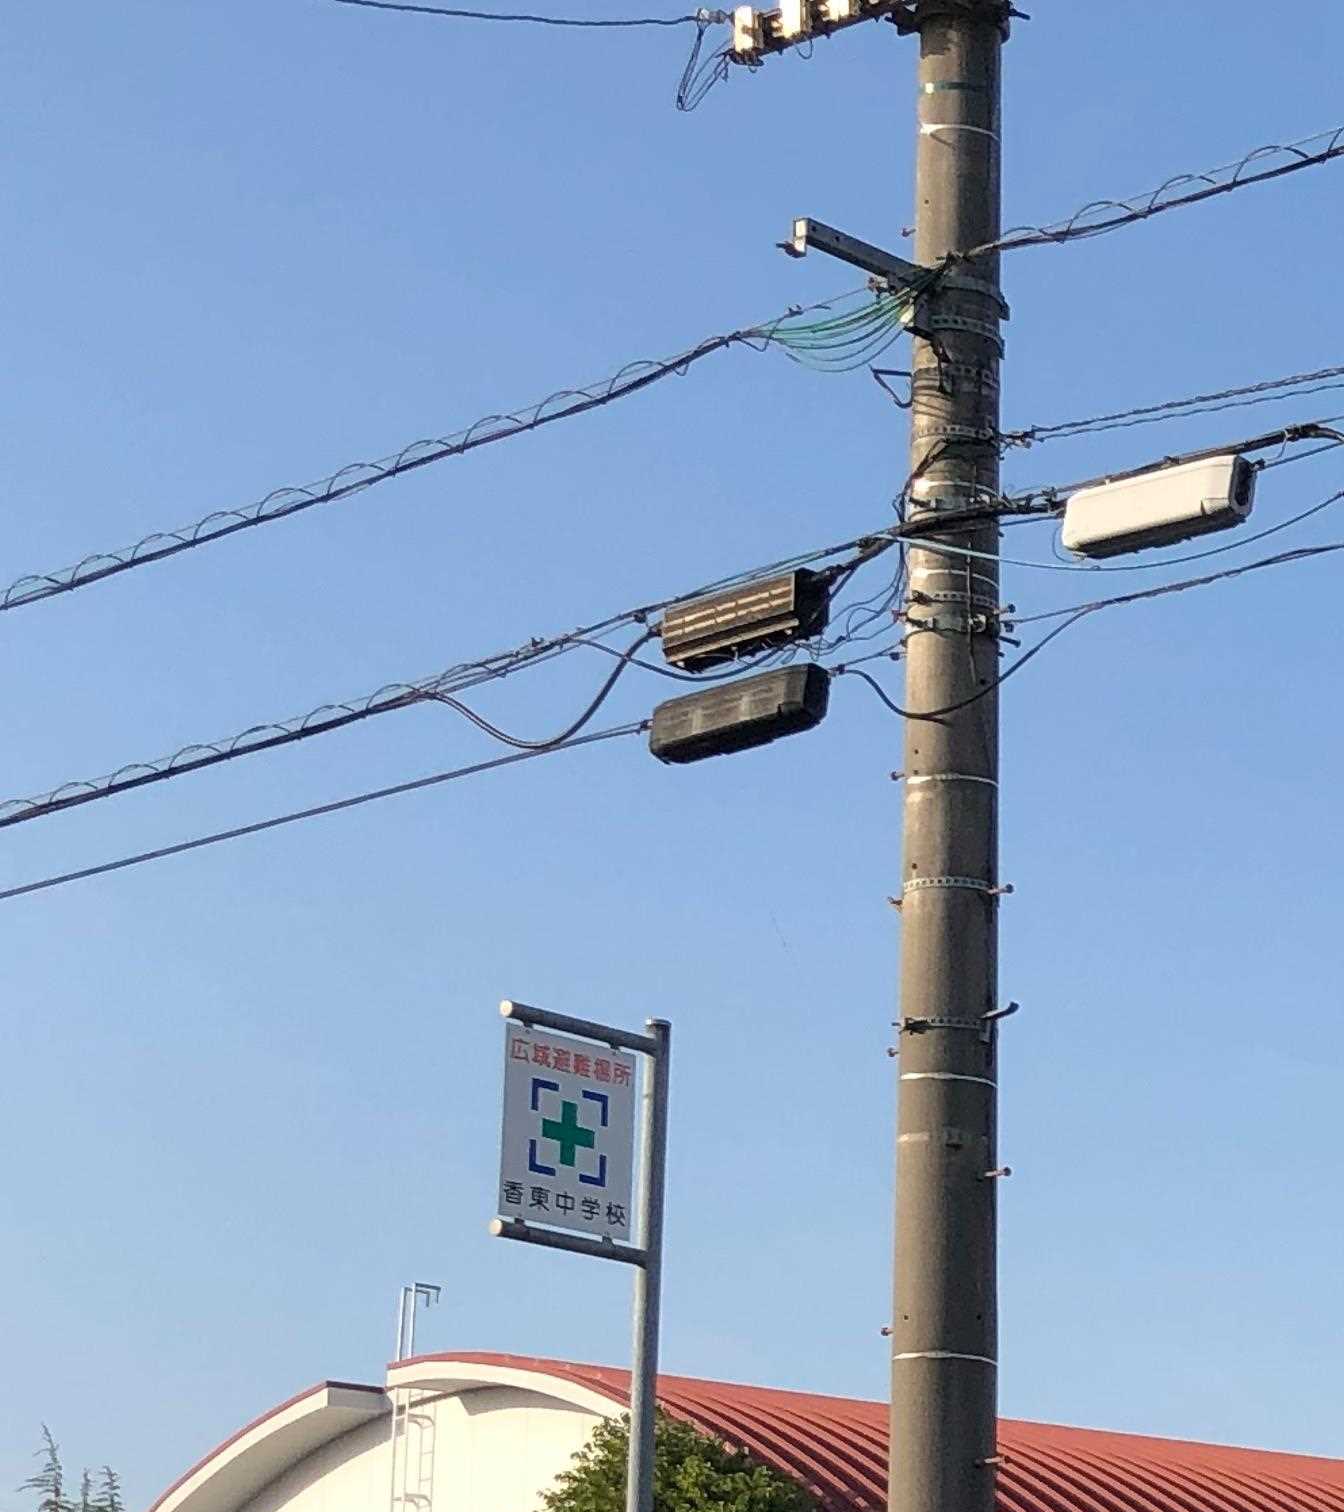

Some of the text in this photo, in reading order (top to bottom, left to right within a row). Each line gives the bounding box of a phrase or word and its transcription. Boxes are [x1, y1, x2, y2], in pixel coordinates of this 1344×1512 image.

[511, 1038, 631, 1088] 広域避難場所
[503, 1180, 627, 1227] 香東中学校
